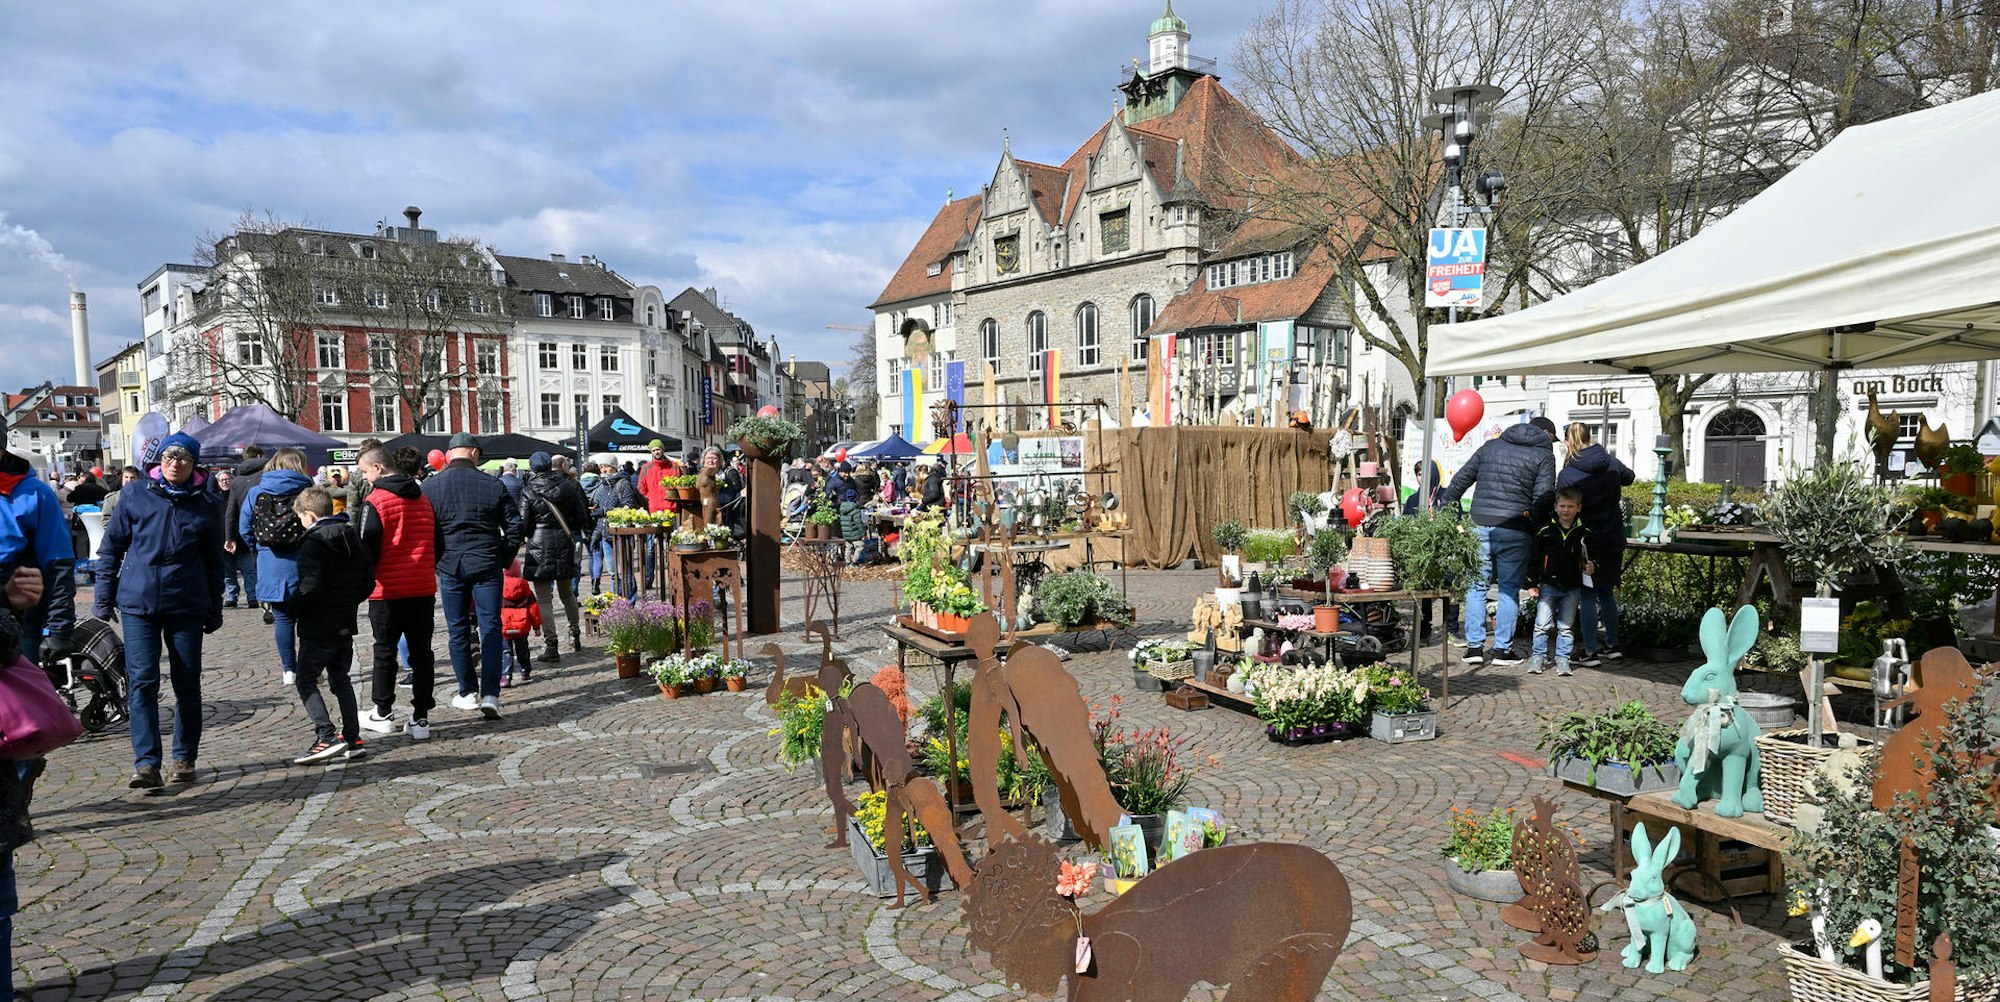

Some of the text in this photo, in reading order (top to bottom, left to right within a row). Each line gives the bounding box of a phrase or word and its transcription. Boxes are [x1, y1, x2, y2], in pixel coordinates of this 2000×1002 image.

[1430, 229, 1478, 258] JA
[1429, 263, 1482, 277] FREIHEIT
[1853, 372, 1944, 395] am Bock
[1577, 386, 1626, 406] Gaffel
[333, 450, 357, 460] eBik
